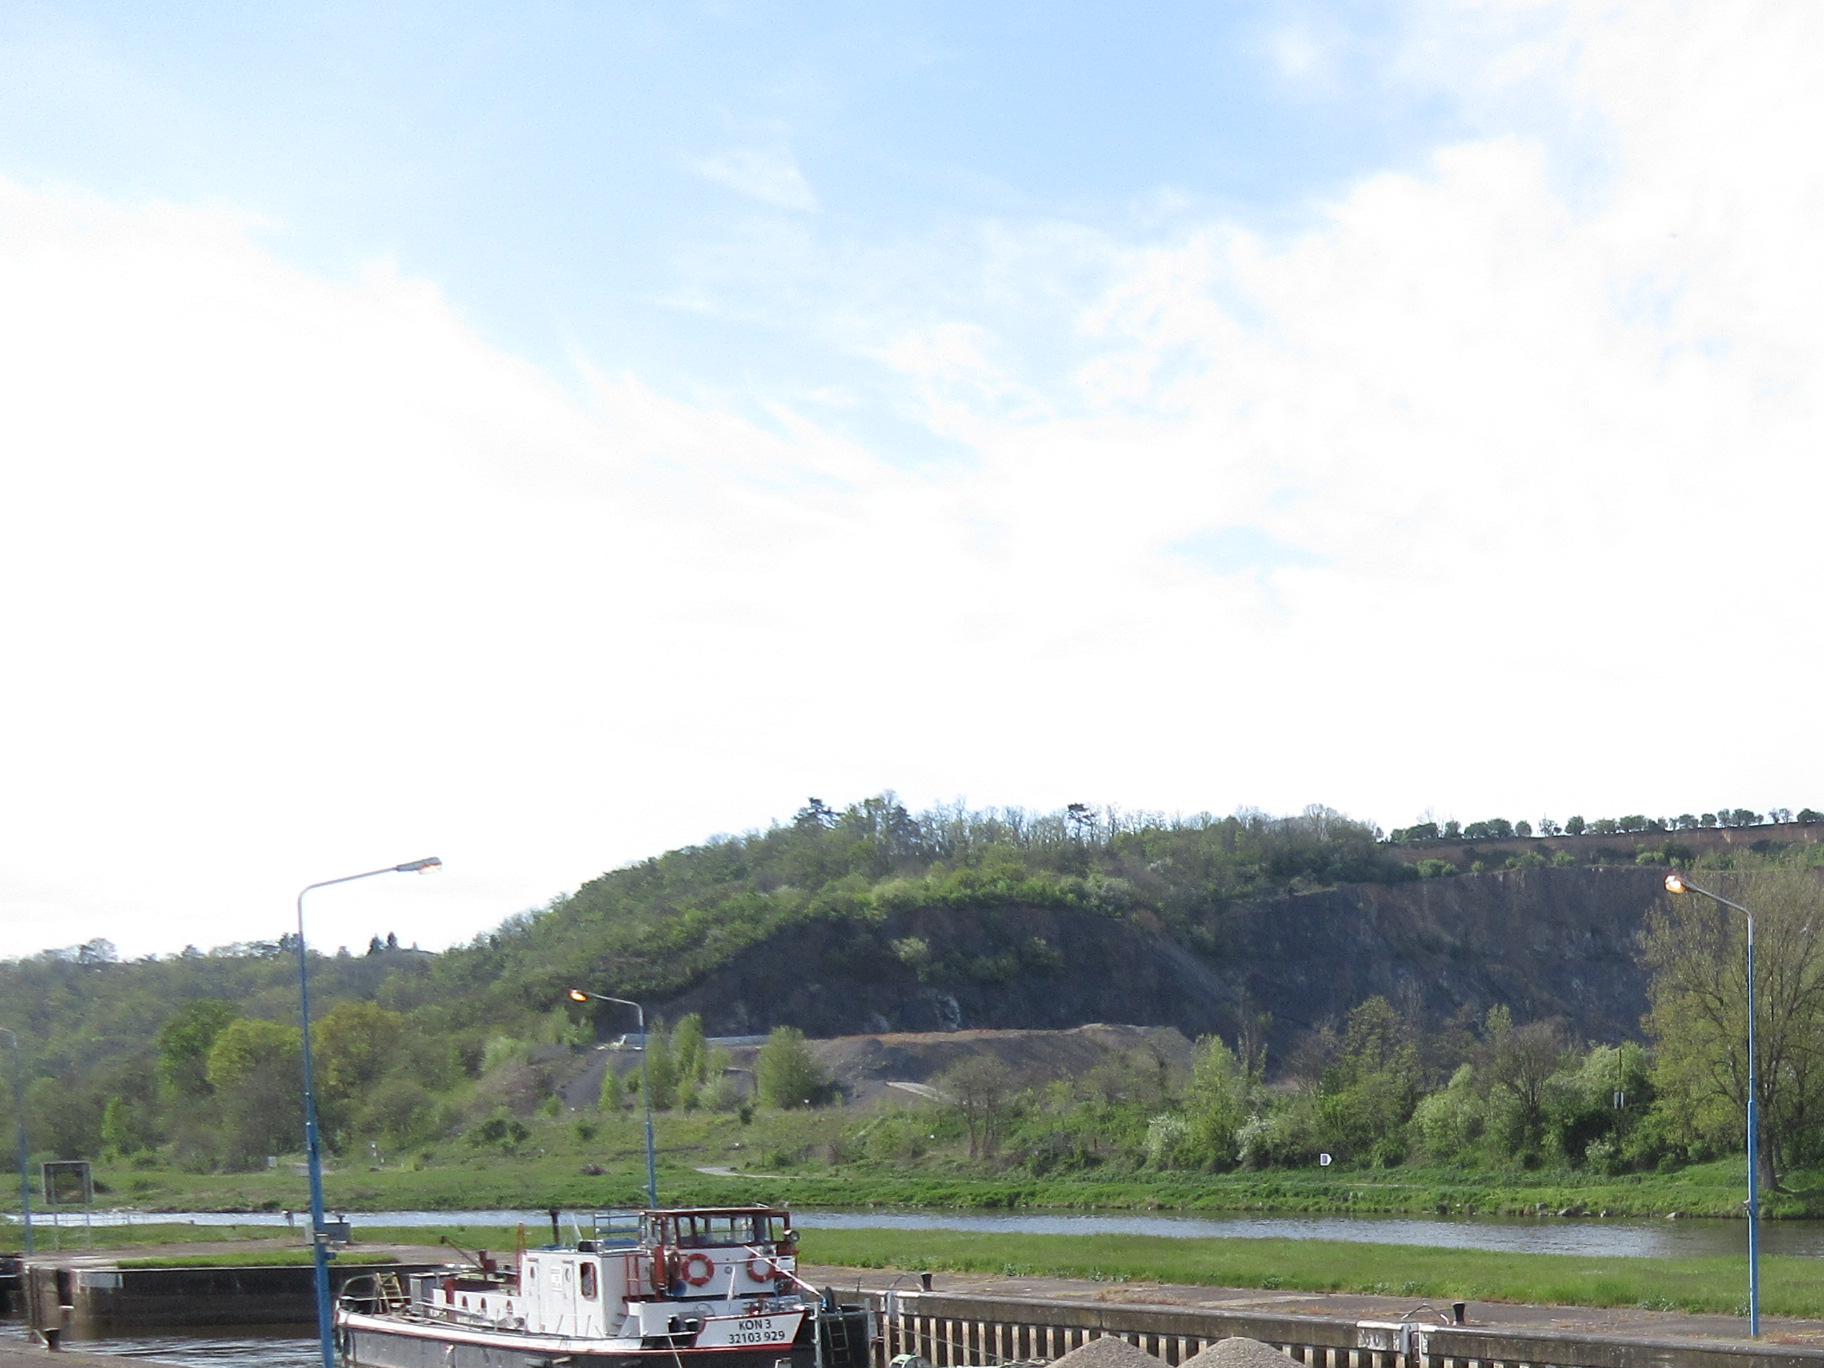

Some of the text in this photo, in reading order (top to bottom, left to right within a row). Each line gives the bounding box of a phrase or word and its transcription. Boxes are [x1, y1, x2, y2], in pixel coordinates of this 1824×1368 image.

[738, 1318, 772, 1331] KON 3
[728, 1330, 786, 1344] 32103 929
